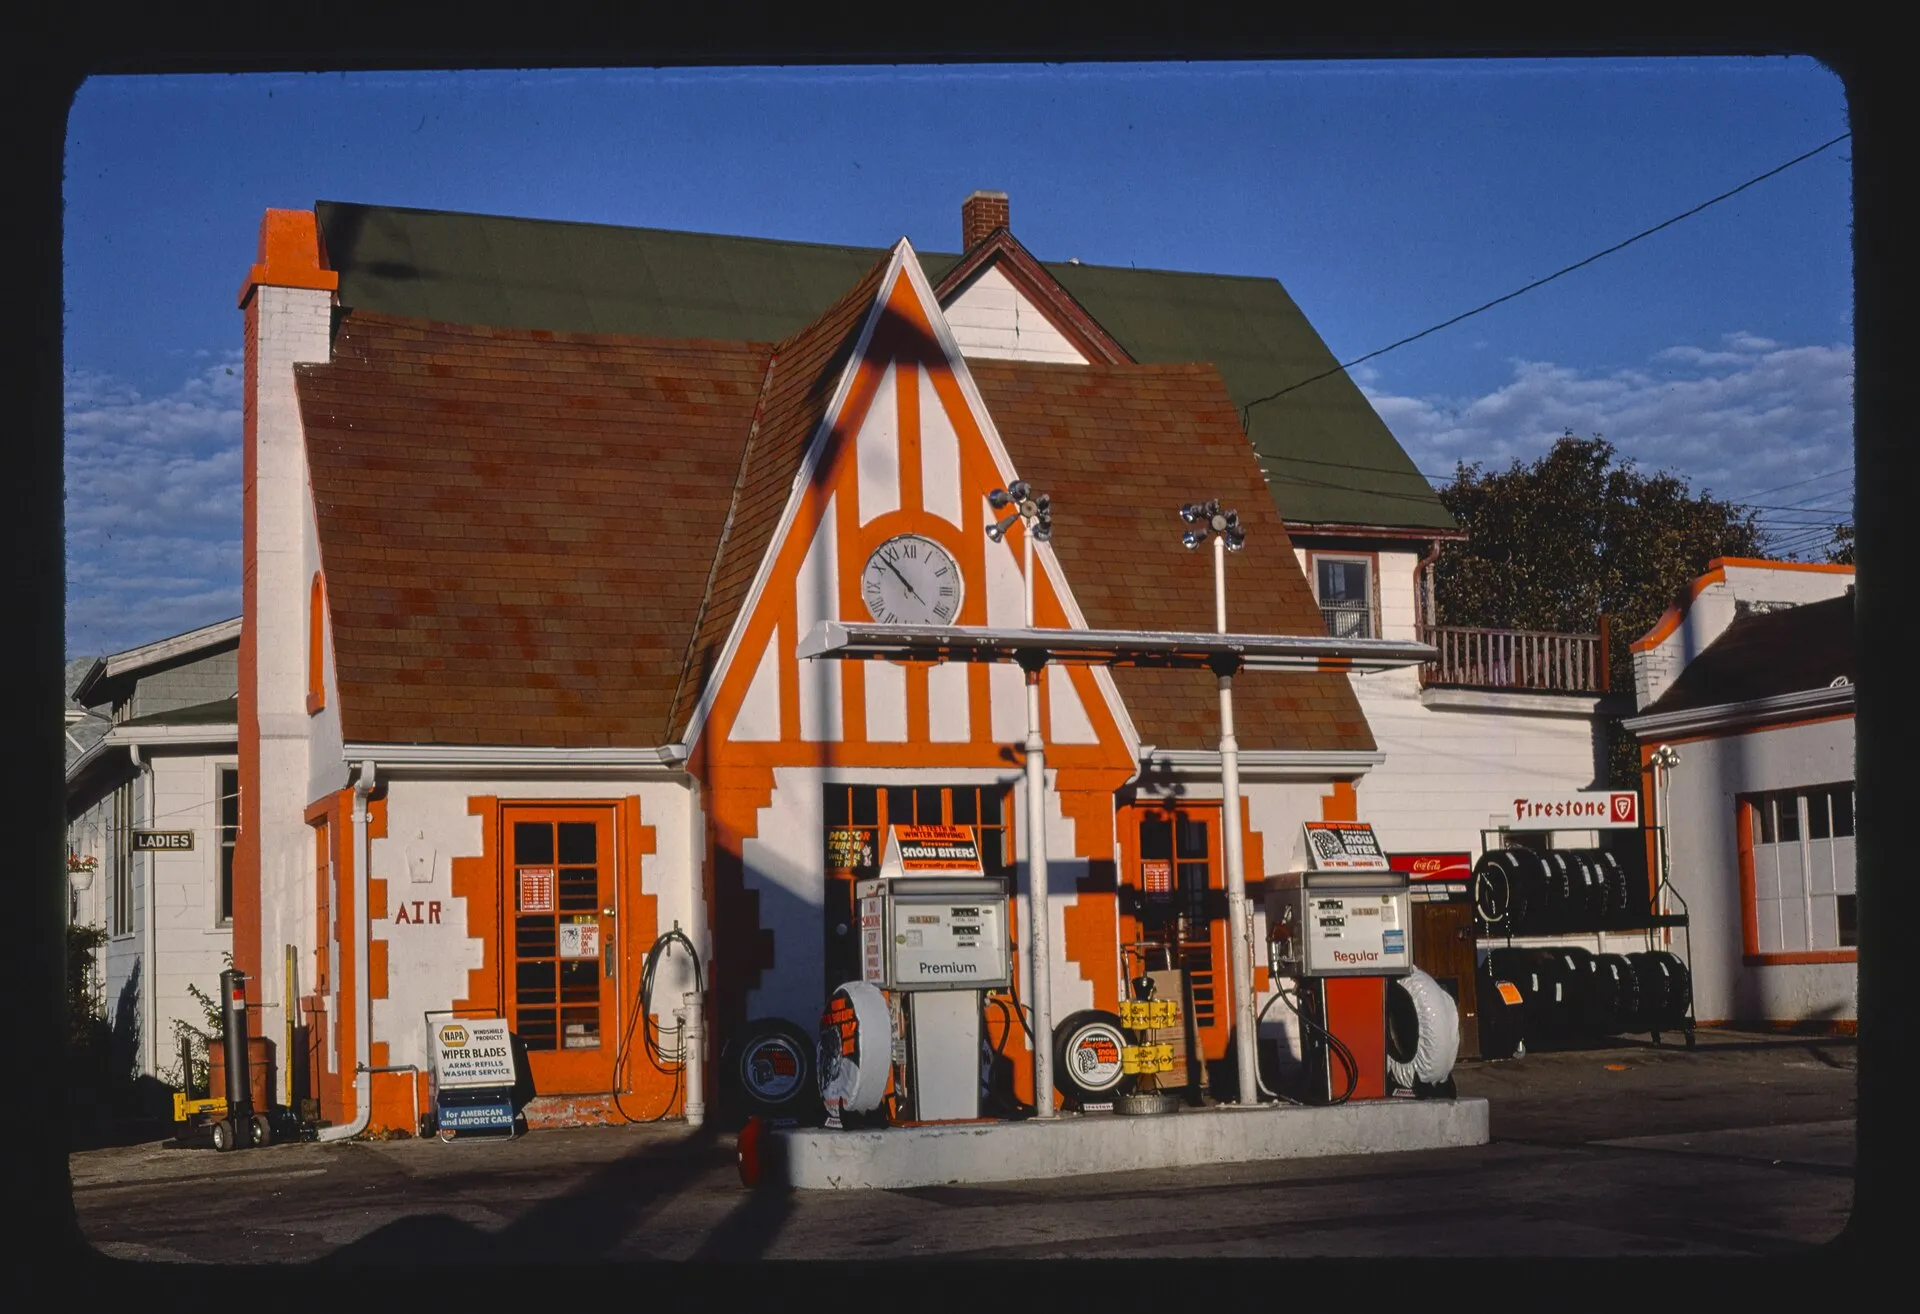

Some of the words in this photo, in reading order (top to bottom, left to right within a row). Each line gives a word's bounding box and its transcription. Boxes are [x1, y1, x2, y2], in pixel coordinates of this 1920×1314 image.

[903, 544, 917, 559] XII
[1513, 798, 1606, 821] Firestone
[138, 835, 189, 848] LADIES
[829, 831, 871, 841] MOTOR
[1343, 835, 1375, 845] SNOW
[902, 847, 937, 858] SNOW
[937, 847, 976, 858] BITERS
[1345, 845, 1378, 854] BITER
[395, 901, 441, 924] AIR
[1333, 950, 1379, 964] Regular
[919, 962, 977, 974] Premium
[444, 1031, 464, 1041] NAPA
[441, 1049, 471, 1060] WIPER
[472, 1047, 507, 1058] BLADES
[1098, 1048, 1117, 1056] SNOW
[443, 1070, 477, 1078] WASHER
[478, 1068, 511, 1076] SERVICE
[445, 1111, 459, 1119] for
[460, 1108, 503, 1118] AMERICAN
[458, 1117, 490, 1125] IMPORT
[491, 1115, 513, 1124] CARS
